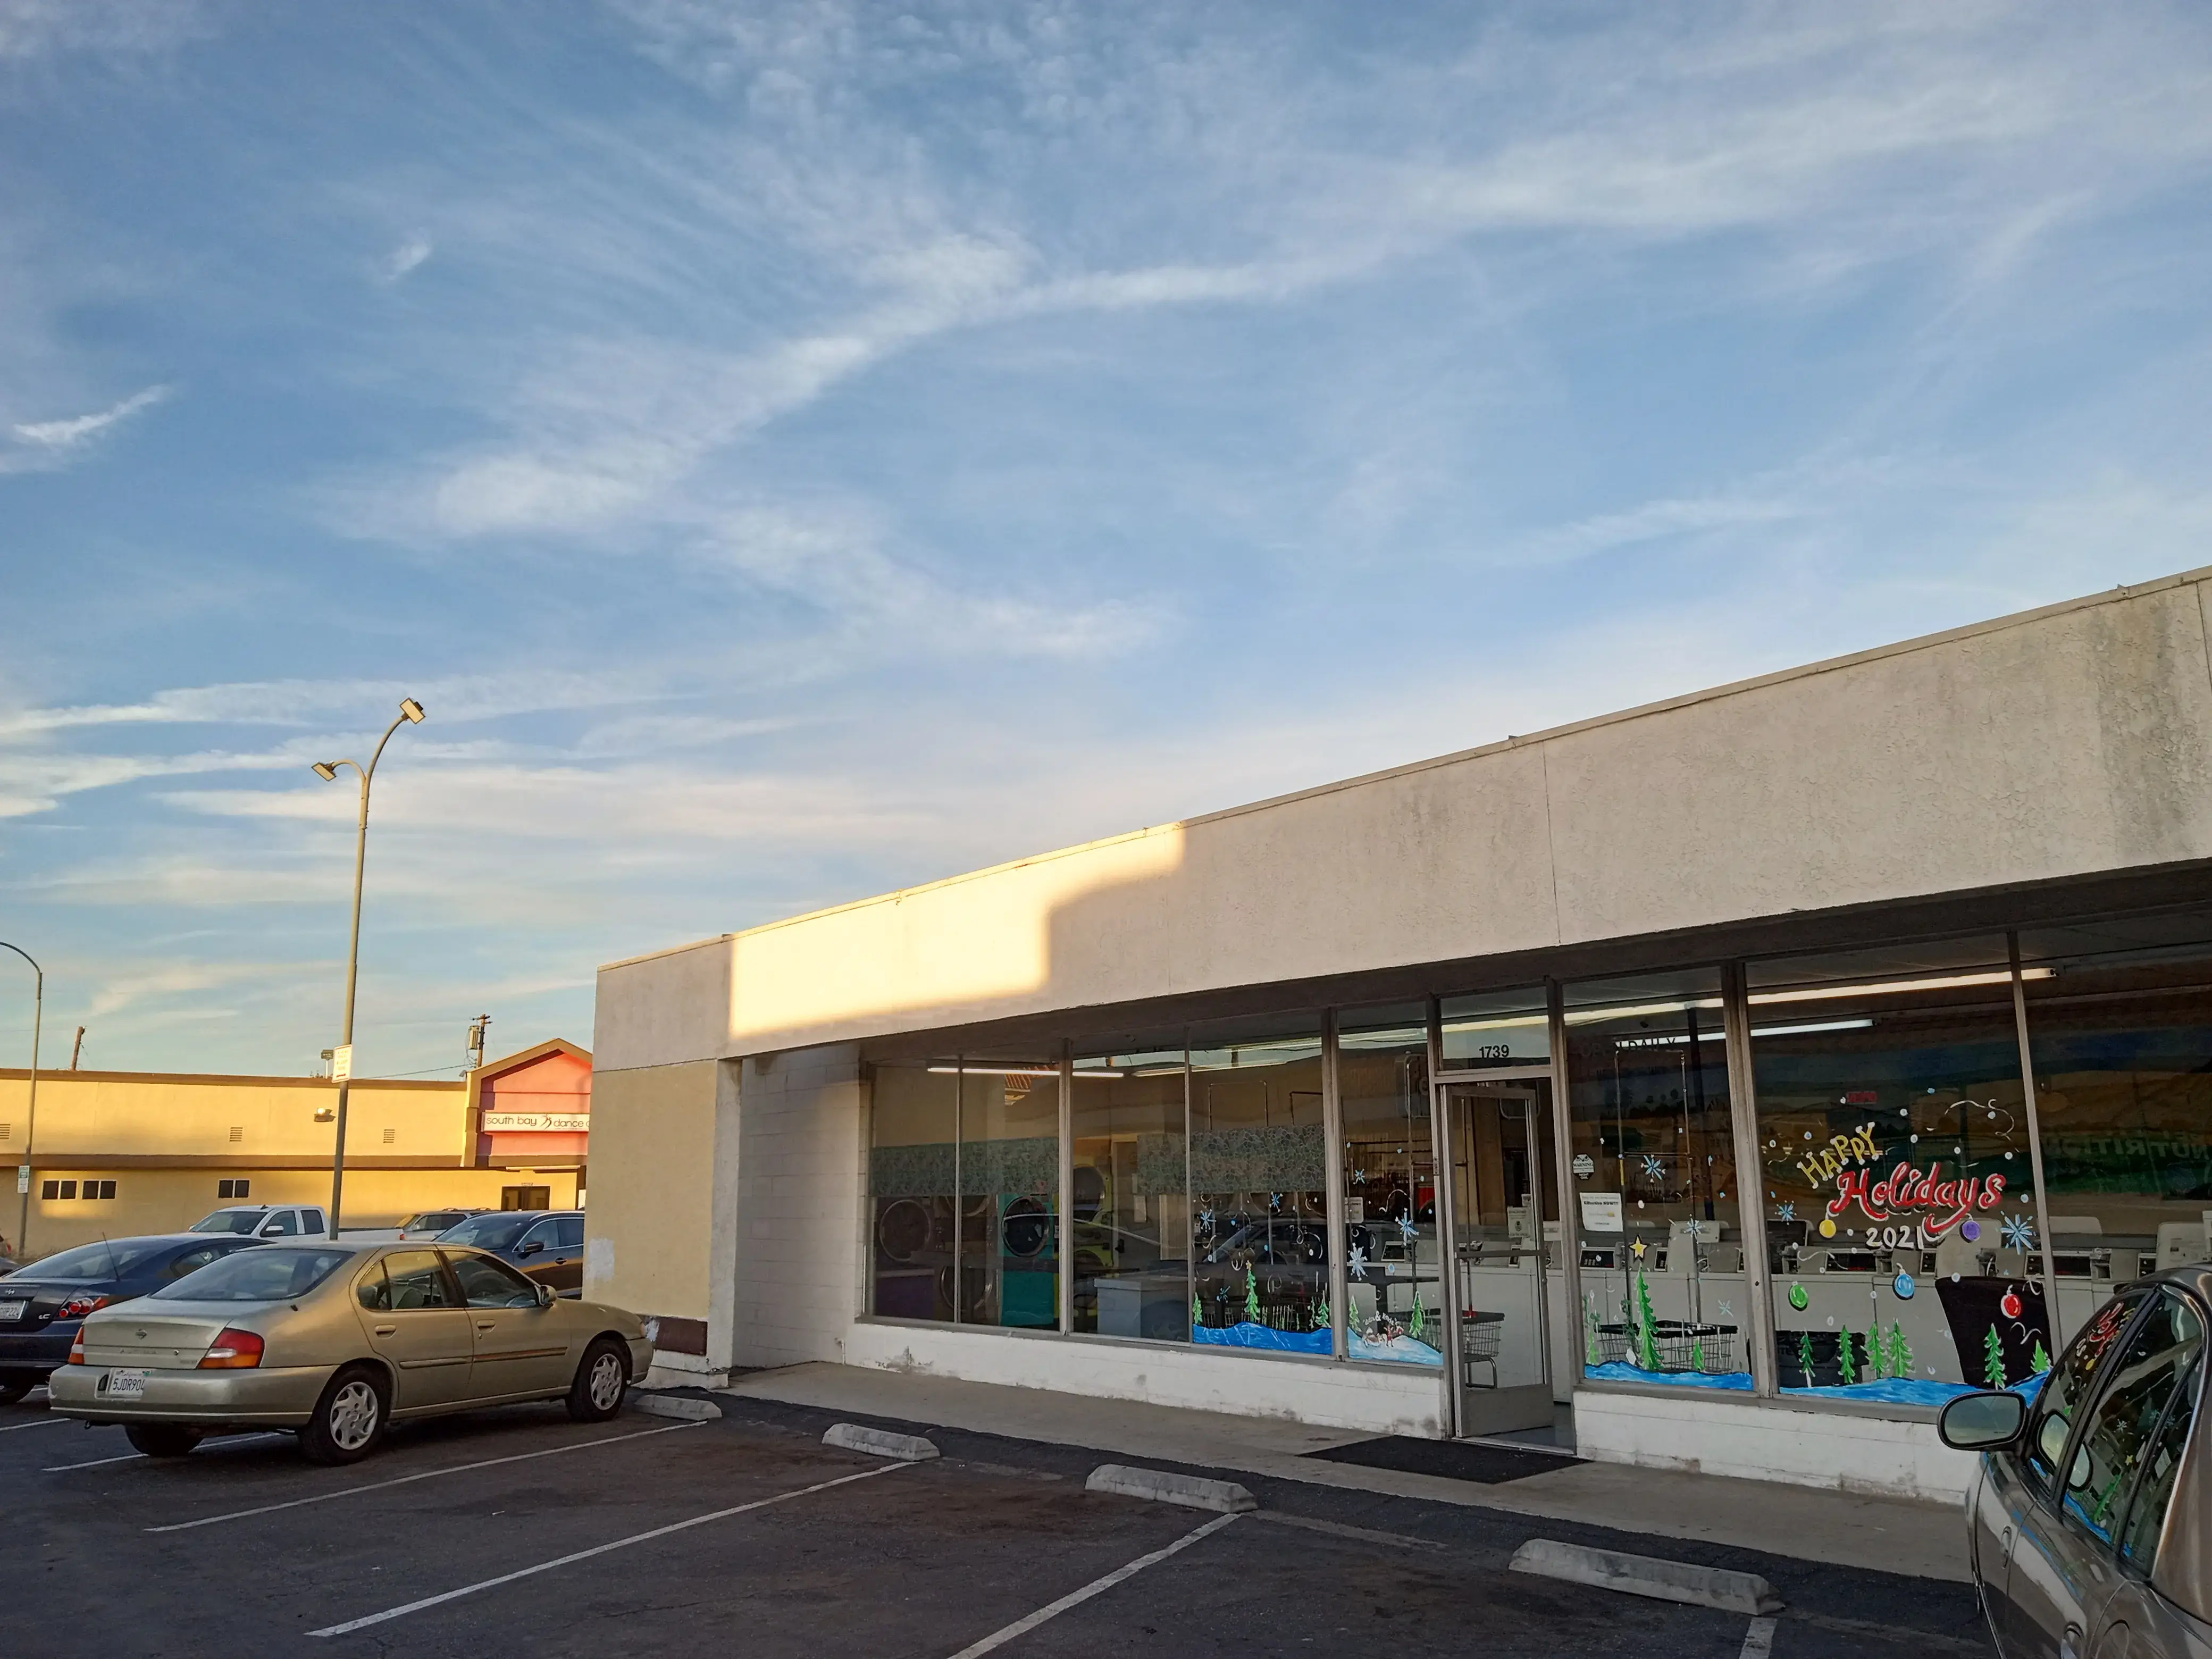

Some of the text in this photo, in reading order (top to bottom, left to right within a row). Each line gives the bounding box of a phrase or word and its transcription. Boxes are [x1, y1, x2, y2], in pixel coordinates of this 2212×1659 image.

[1479, 1044, 1509, 1058] 1739
[486, 1116, 514, 1125] south
[517, 1117, 537, 1126] bay
[1797, 1121, 1876, 1189] HAPPY
[1826, 1161, 2006, 1242] Holidays
[1866, 1225, 1924, 1250] 2021
